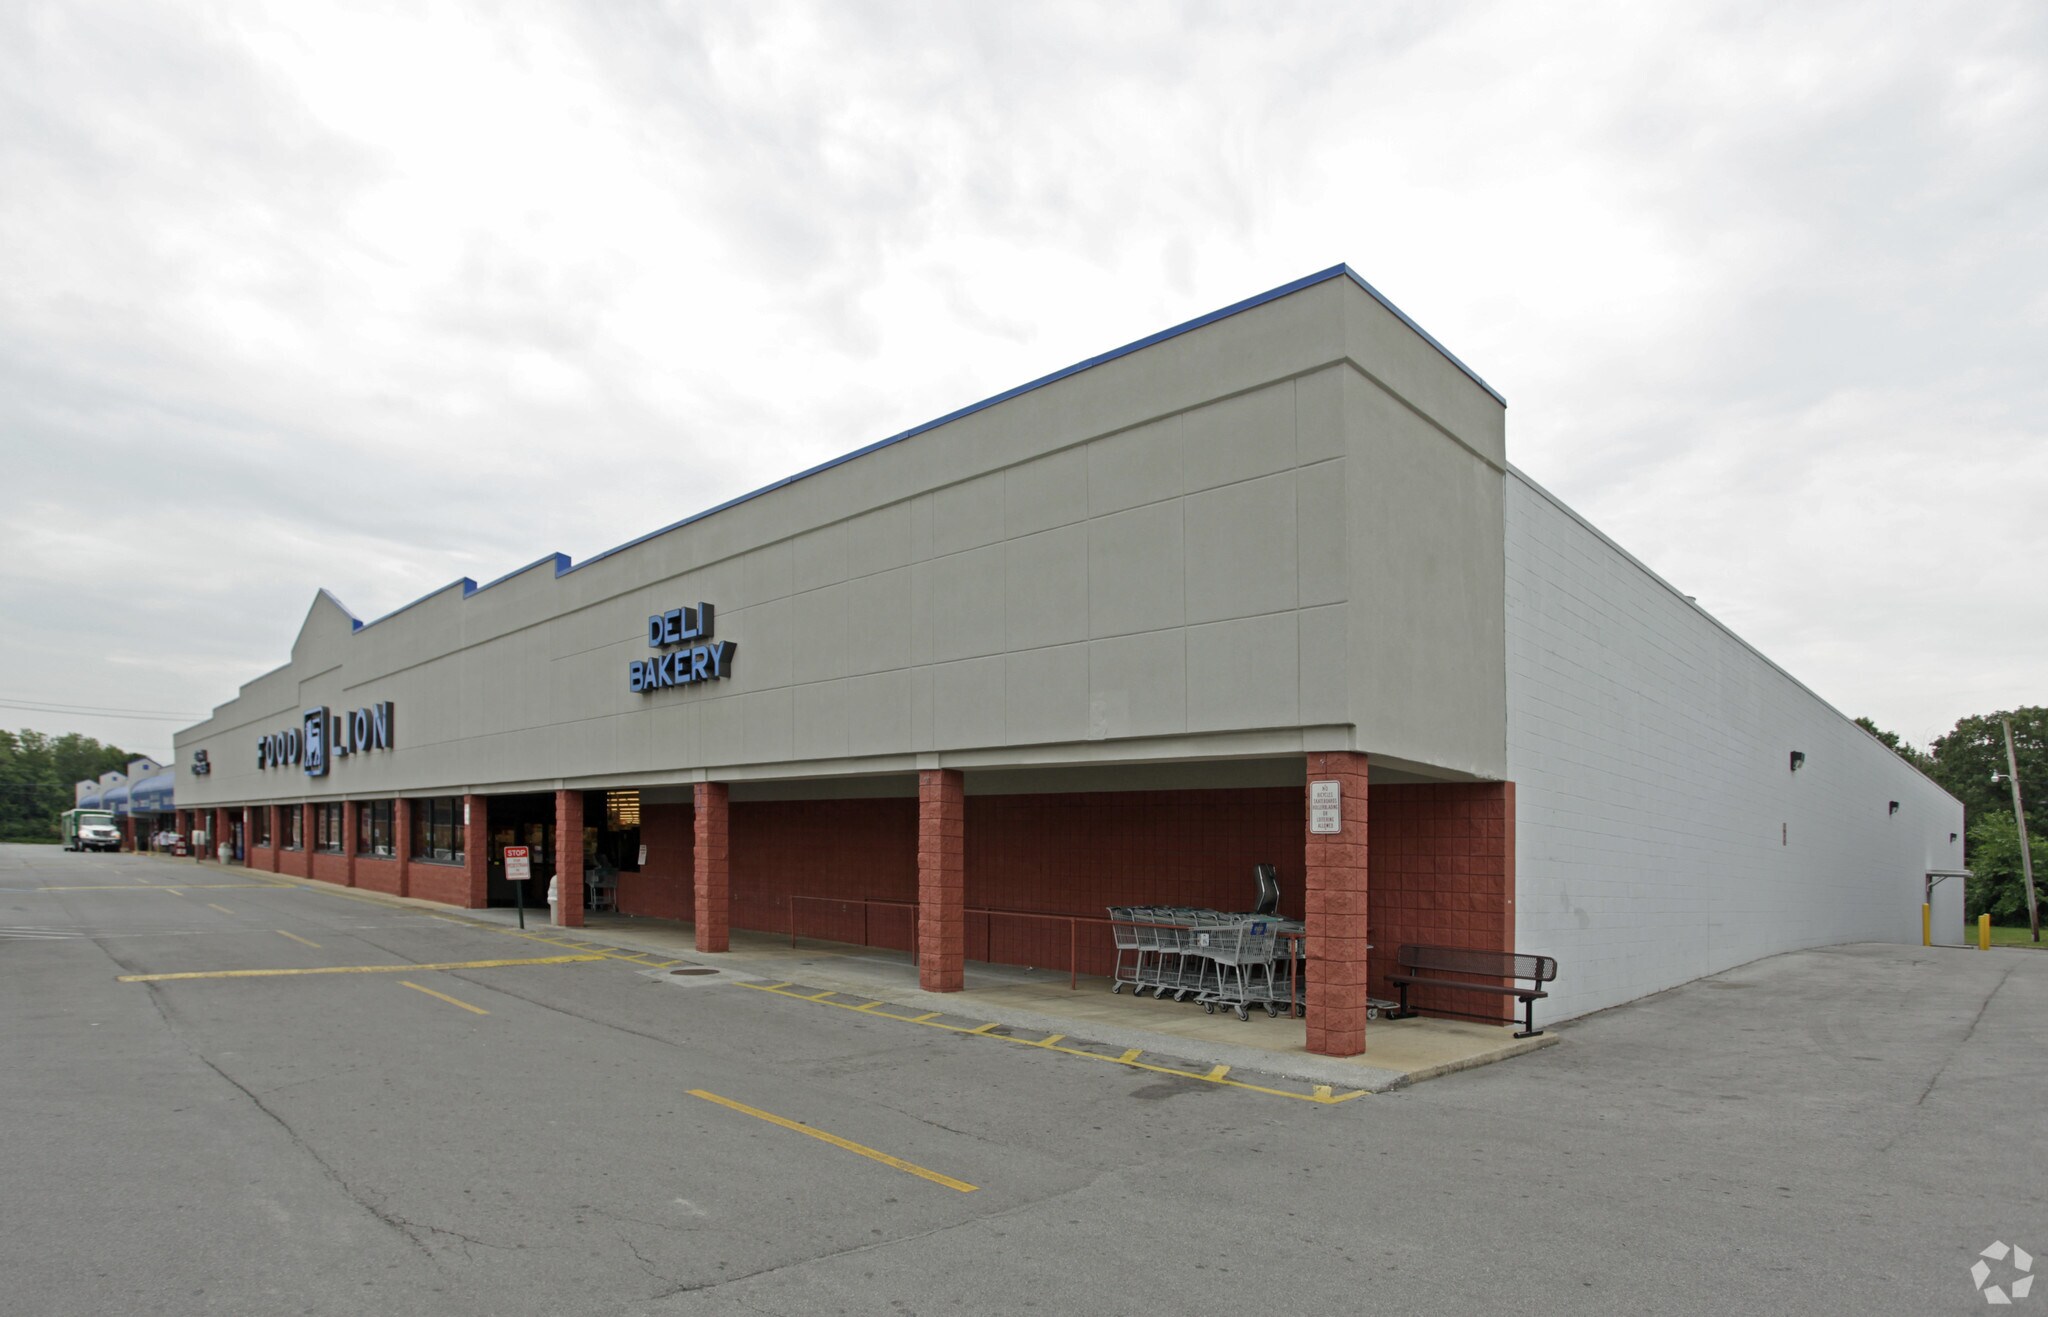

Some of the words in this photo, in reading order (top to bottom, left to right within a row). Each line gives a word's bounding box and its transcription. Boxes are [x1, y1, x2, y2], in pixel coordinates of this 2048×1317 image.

[648, 602, 714, 648] DELI
[629, 640, 737, 693] BAKERY
[258, 727, 302, 770] FOOD
[332, 701, 394, 756] LION
